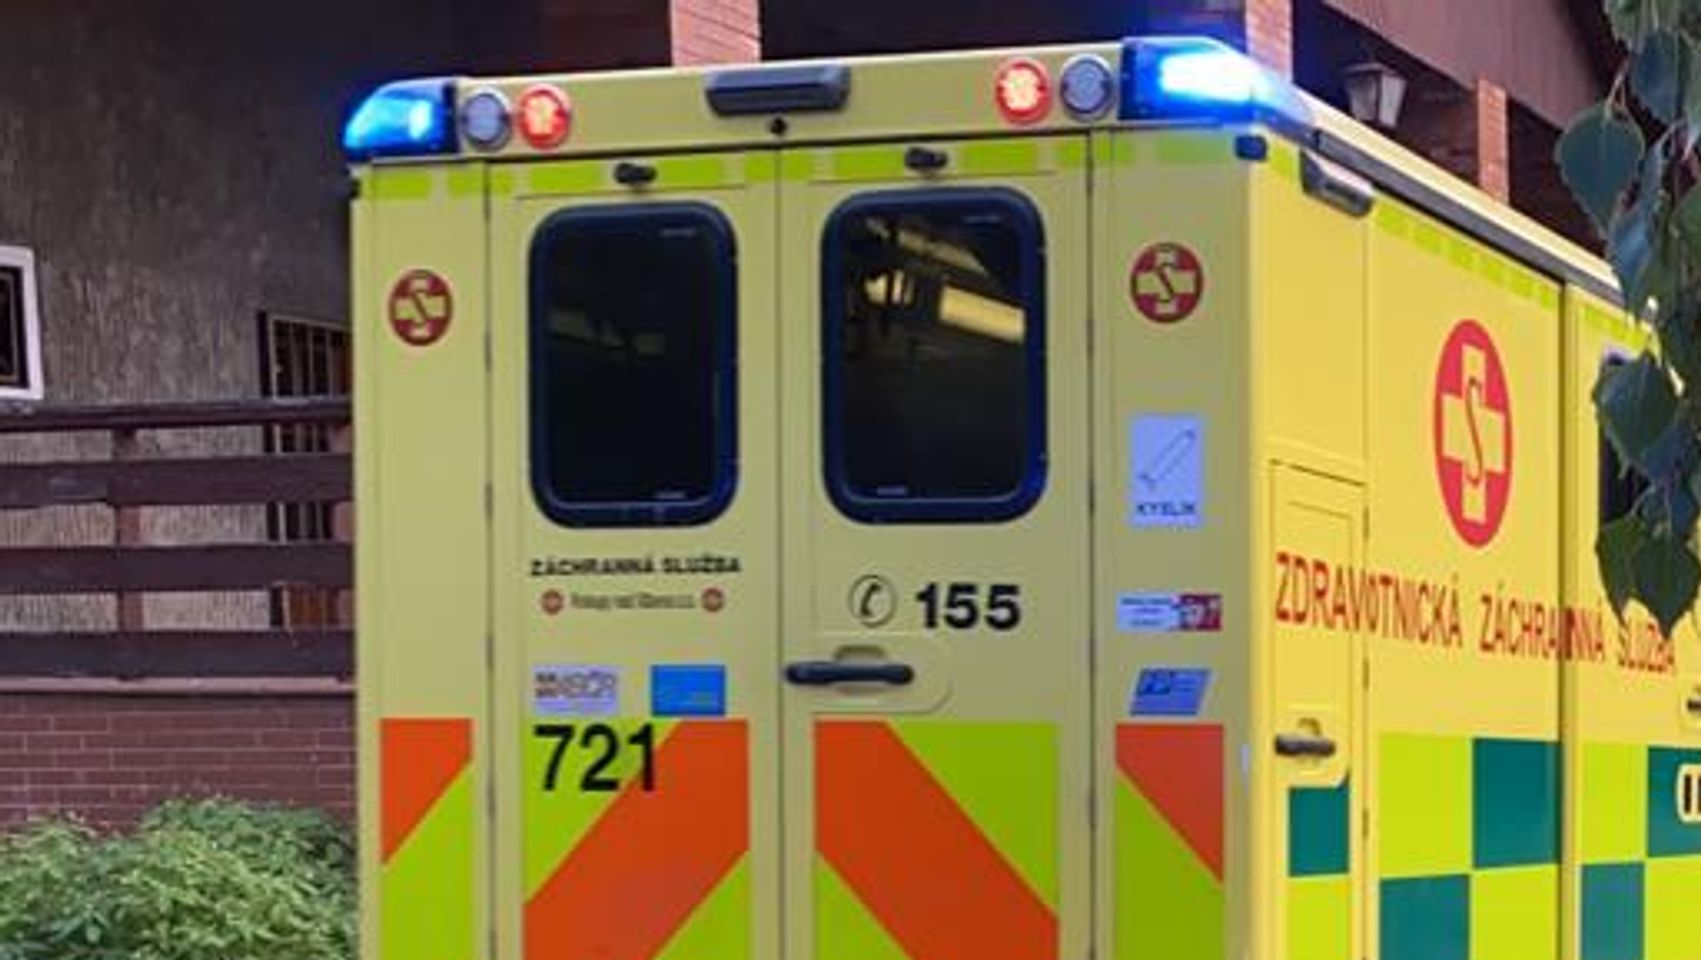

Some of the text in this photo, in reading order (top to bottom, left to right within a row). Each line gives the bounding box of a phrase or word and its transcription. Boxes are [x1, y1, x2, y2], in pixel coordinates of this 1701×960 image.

[530, 551, 741, 576] ZÁCHRANNÁ SLUŽBA
[916, 582, 1022, 630] 155
[1275, 551, 1464, 649] ZDRAVOTNICKÁ
[1479, 578, 1605, 662] ZÁCHRANNÁ
[533, 722, 656, 792] 721
